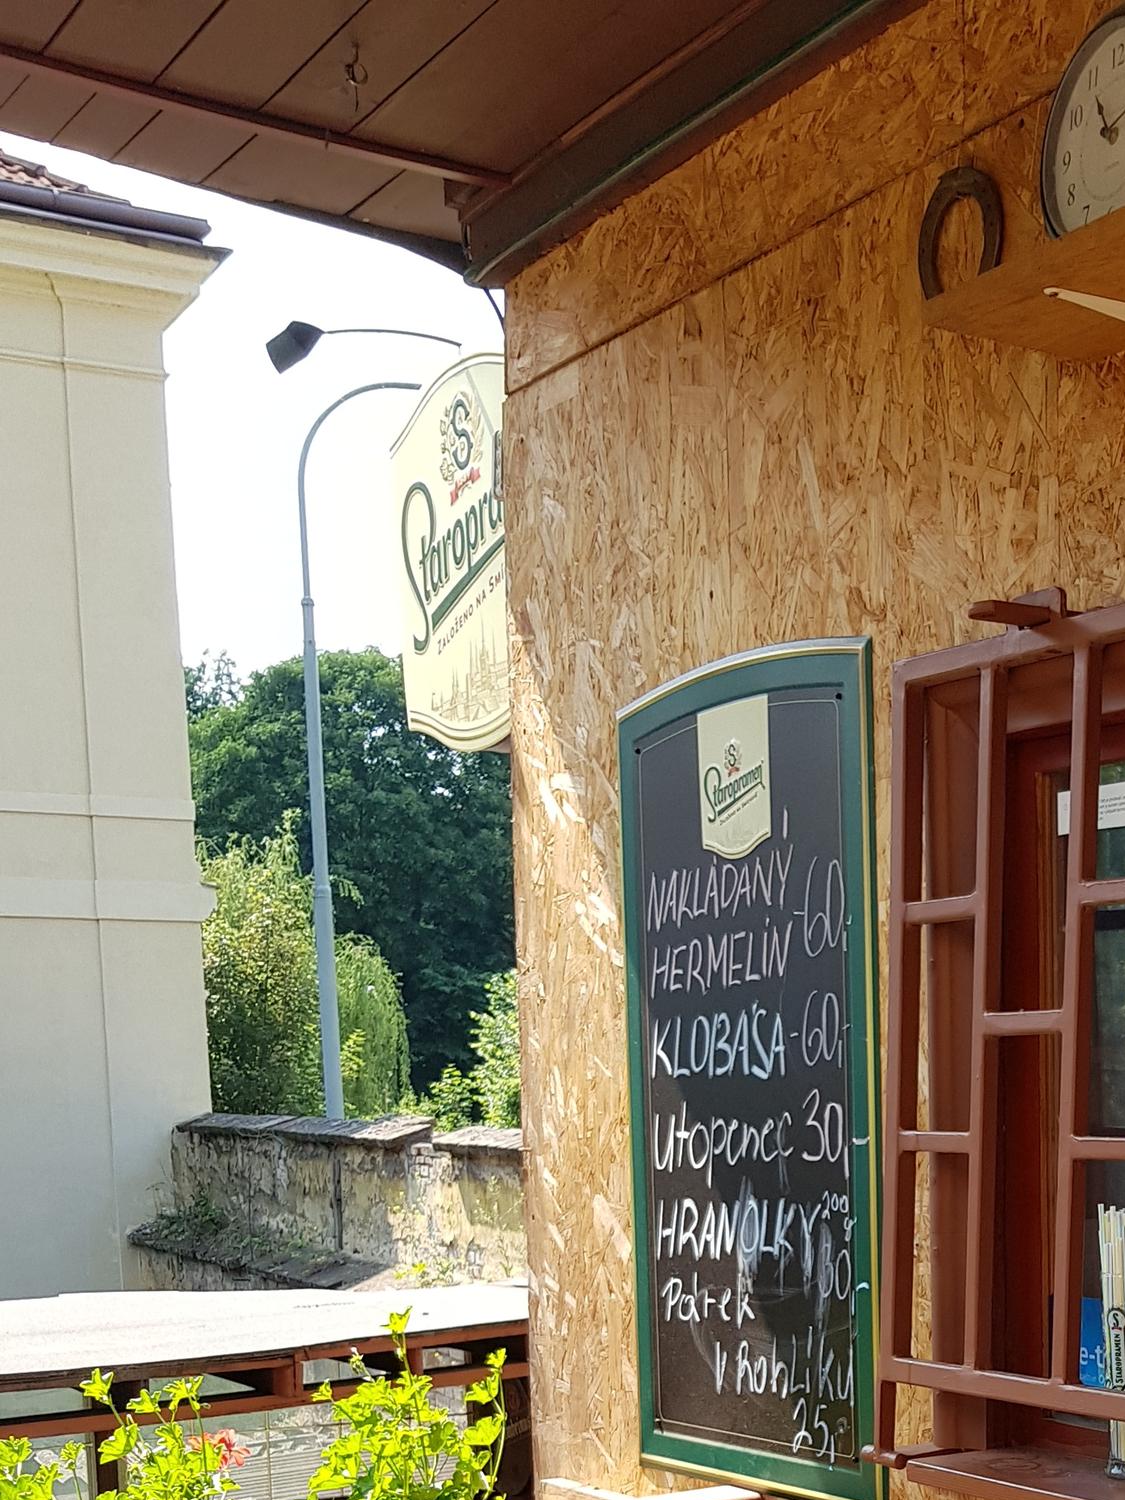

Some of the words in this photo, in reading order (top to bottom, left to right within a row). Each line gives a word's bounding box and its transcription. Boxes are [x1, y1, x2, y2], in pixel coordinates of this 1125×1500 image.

[1112, 43, 1125, 69] 12
[1088, 66, 1099, 91] 11
[1069, 105, 1083, 131] 10
[1062, 151, 1071, 175] 9
[1067, 183, 1075, 206] 8
[438, 604, 473, 655] ZALOŽENO
[476, 589, 487, 609] NA
[647, 808, 794, 933] NAKLÁDANÝ
[650, 916, 794, 1000] HERMELÍN
